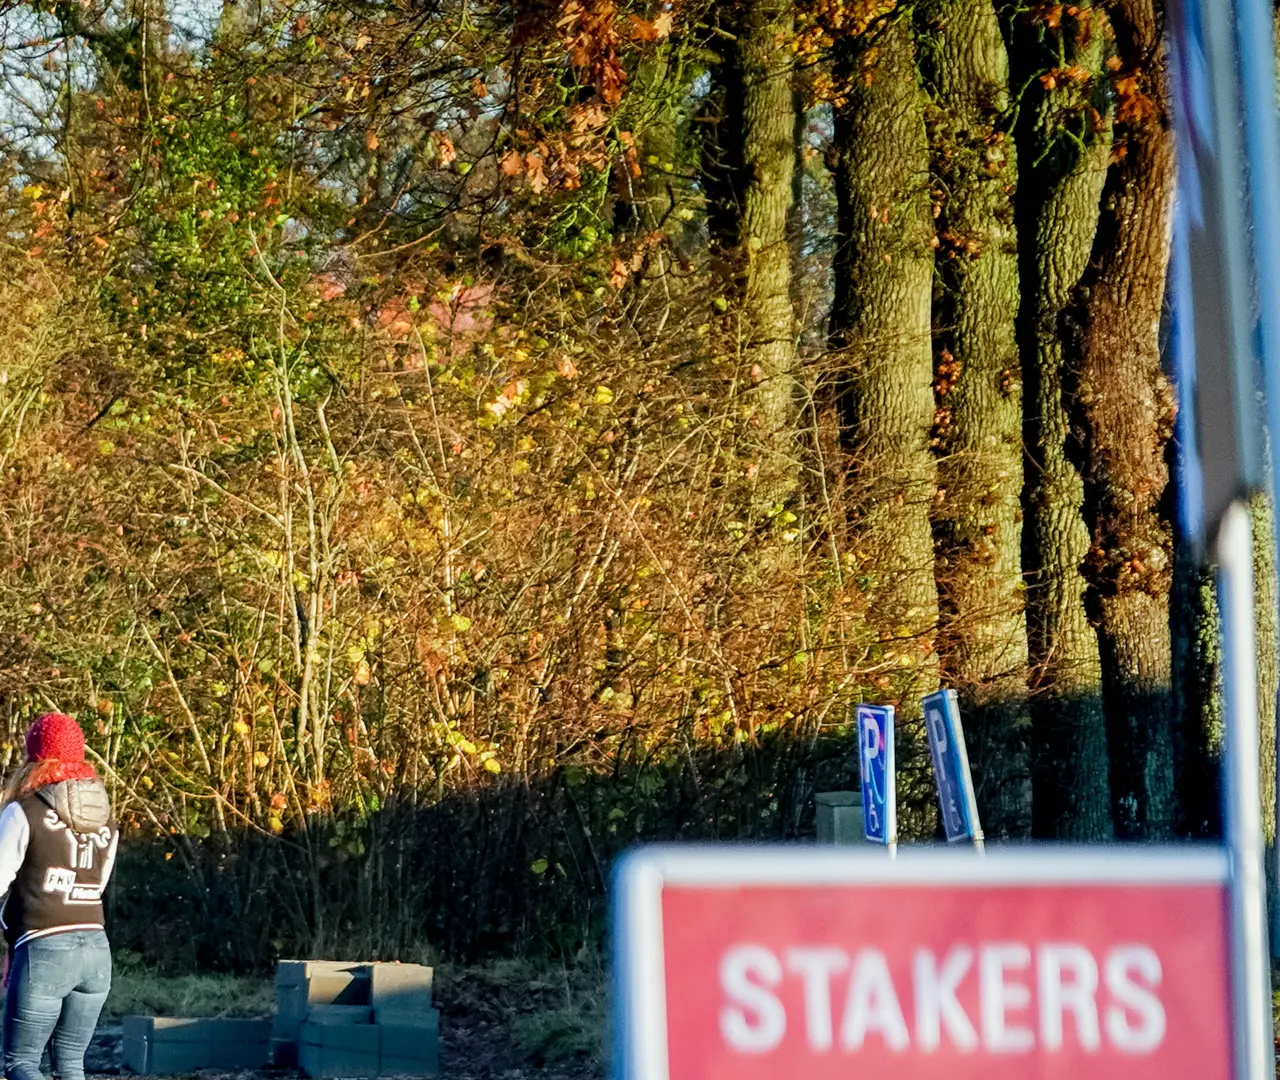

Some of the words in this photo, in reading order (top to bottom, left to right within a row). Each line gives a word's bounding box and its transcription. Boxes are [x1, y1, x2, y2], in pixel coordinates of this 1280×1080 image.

[864, 717, 880, 783] P
[929, 708, 947, 781] P
[720, 943, 1167, 1054] STAKERS
